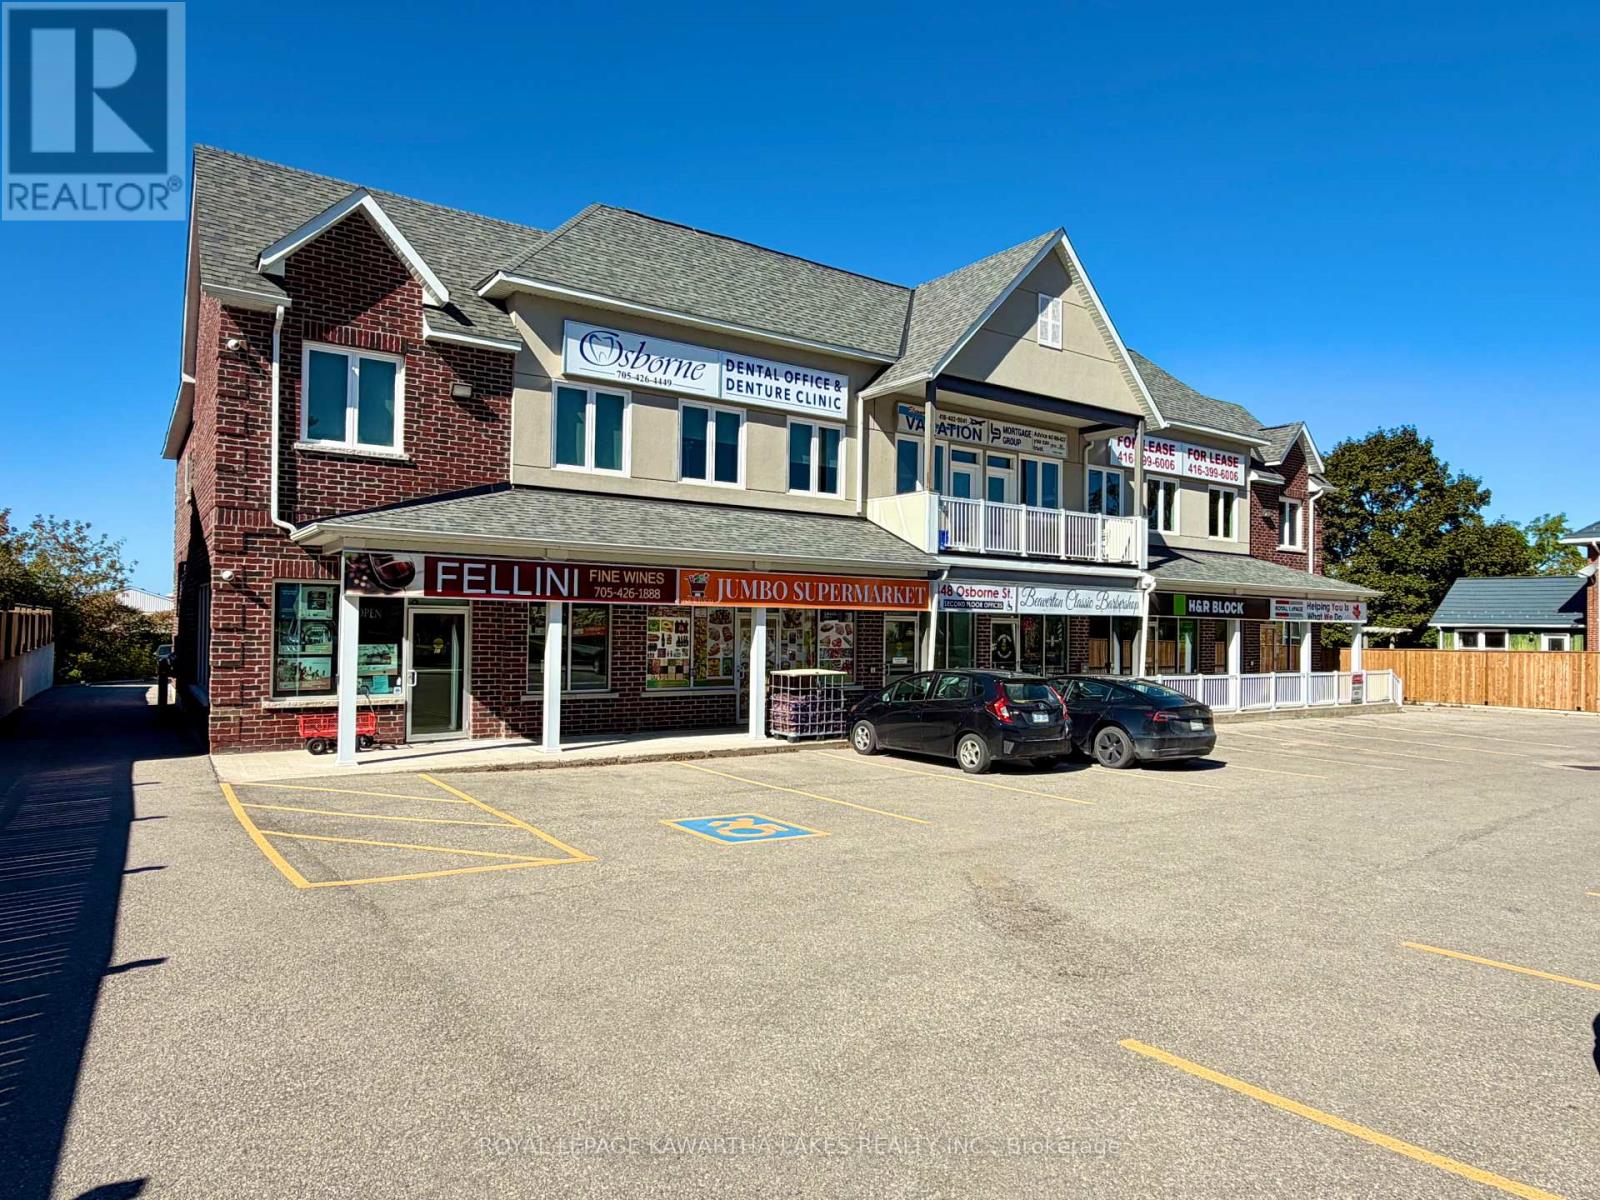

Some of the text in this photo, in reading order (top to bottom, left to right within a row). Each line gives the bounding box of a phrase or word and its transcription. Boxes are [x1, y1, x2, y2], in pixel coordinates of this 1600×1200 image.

[579, 330, 706, 381] Osborne
[616, 370, 673, 387] 705-426-4449
[726, 358, 842, 393] DENTAL OFFICE &
[726, 378, 842, 410] DENTURE CLINIC
[905, 415, 982, 442] VAATION
[1002, 425, 1032, 439] MORTGAGE
[1002, 436, 1021, 447] GROUP
[1143, 439, 1175, 456] LEASE
[1117, 450, 1175, 471] 41699-6006
[1187, 447, 1239, 468] FOR LEASE
[1188, 463, 1239, 482] 416-399-6006
[436, 561, 579, 597] FELLINI
[589, 569, 664, 585] FINE WINES
[594, 587, 661, 600] 705-426-1888
[715, 578, 927, 605] JUMBO SUPERMARKET
[957, 585, 999, 599] Osborne
[1002, 587, 1013, 599] St.
[1019, 586, 1140, 614] Beaverton Classic Barbershop
[1188, 599, 1244, 614] H&R BLOCK
[1306, 601, 1330, 612] Helping
[1332, 602, 1343, 611] You
[1307, 612, 1322, 620] What
